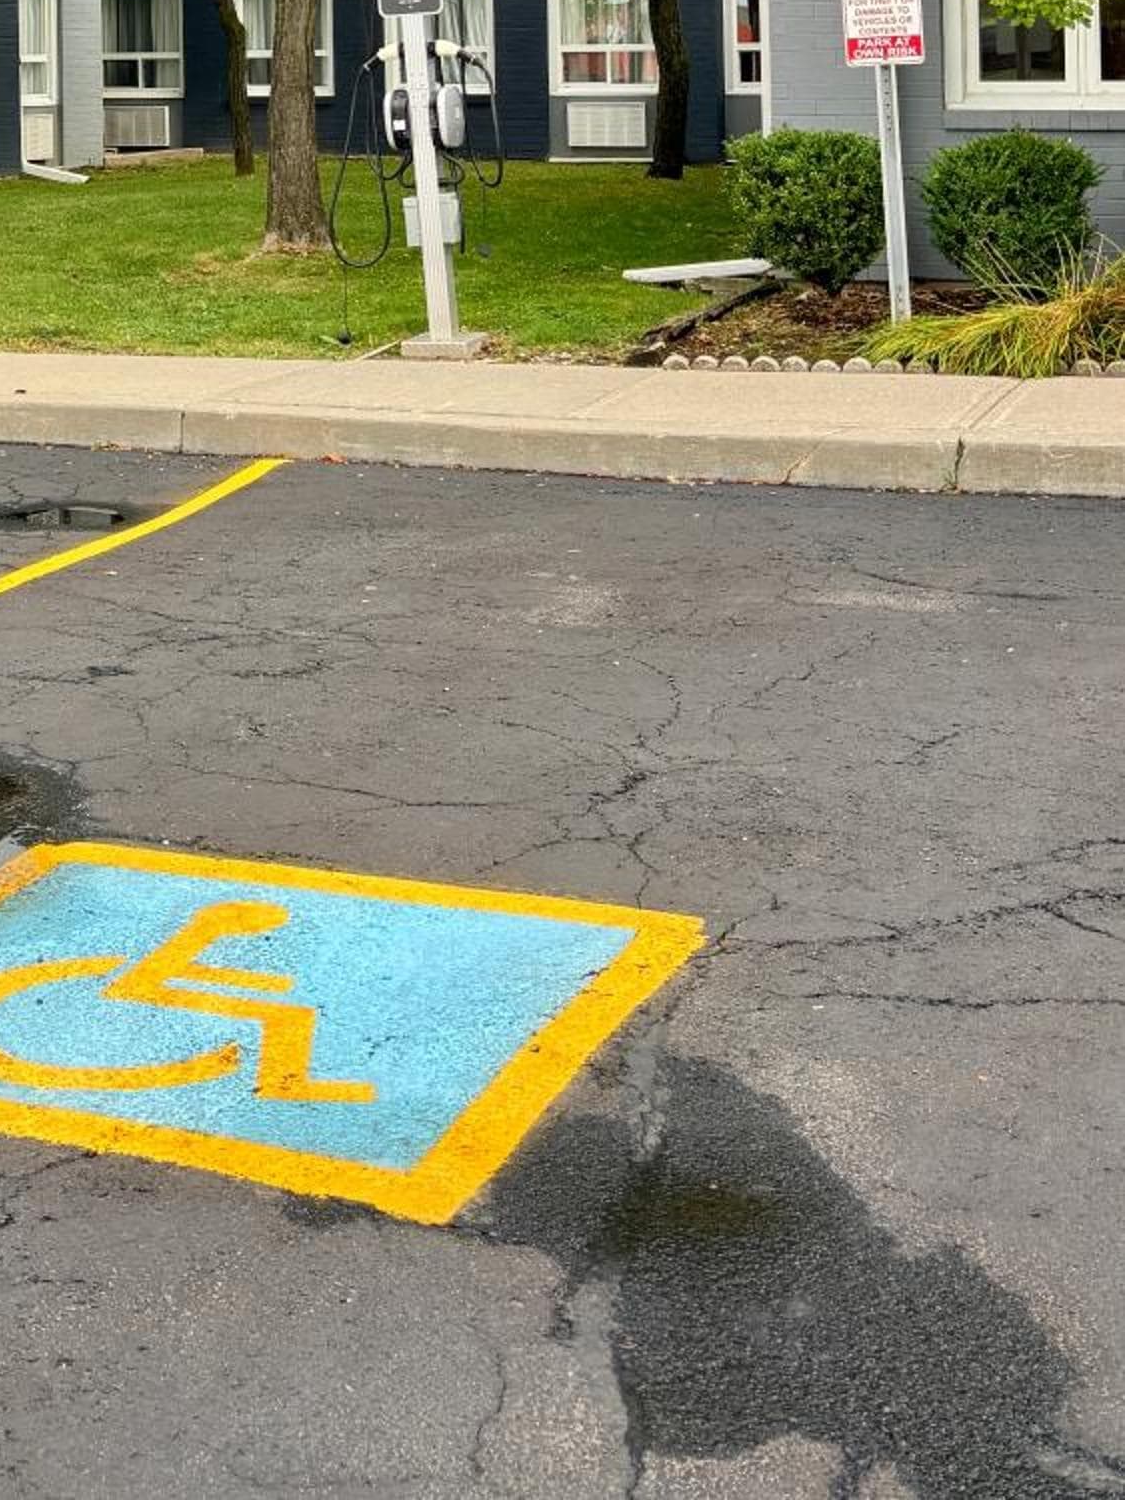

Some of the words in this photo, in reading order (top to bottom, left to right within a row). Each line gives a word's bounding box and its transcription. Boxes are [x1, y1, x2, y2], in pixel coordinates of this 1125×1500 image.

[854, 7, 895, 17] DAMAGE
[898, 6, 911, 15] TO
[853, 17, 897, 27] VEHICLES
[858, 26, 909, 36] CONTENTS
[858, 37, 892, 49] PARK
[896, 36, 911, 47] AT
[853, 47, 884, 59] OWN
[888, 45, 919, 57] RISK
